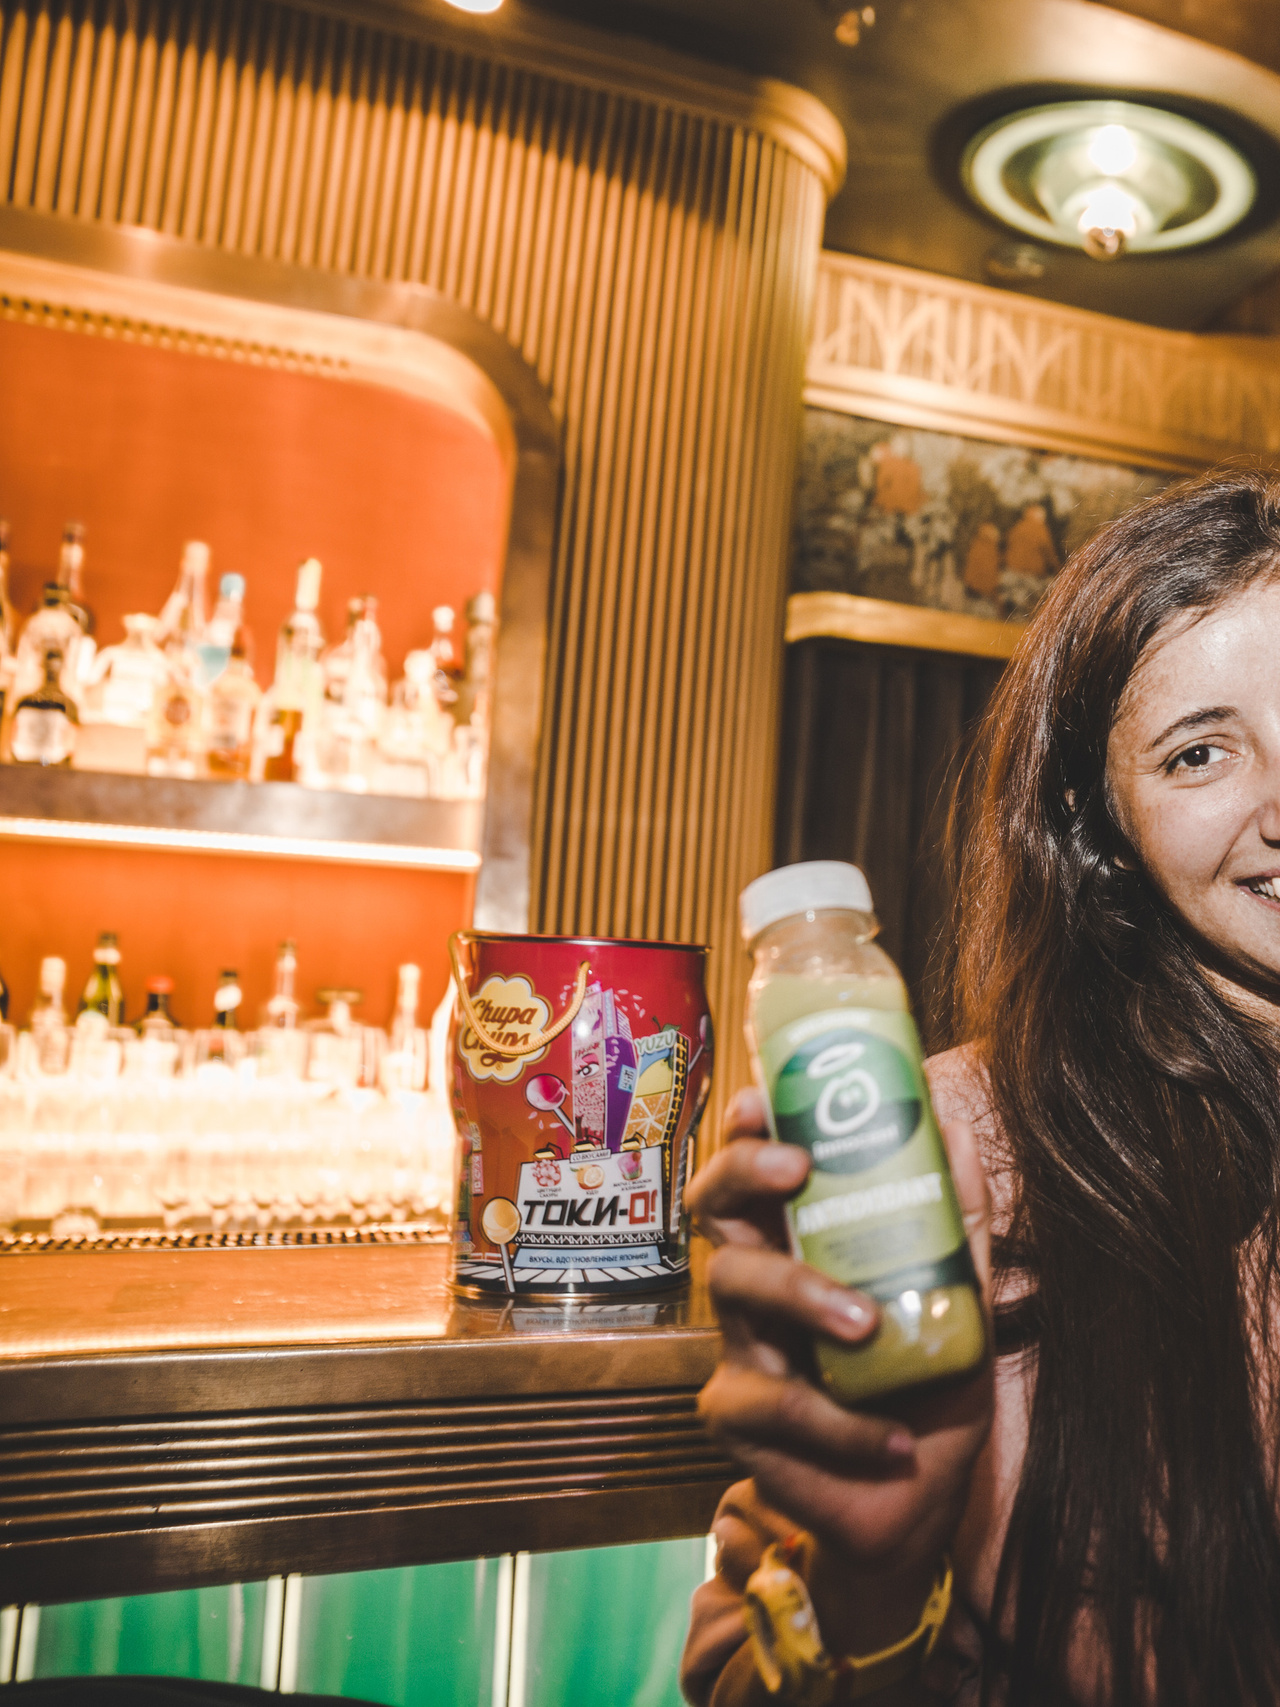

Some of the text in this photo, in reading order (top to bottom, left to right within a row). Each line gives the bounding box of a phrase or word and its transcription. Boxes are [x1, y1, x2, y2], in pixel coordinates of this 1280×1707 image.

[473, 999, 538, 1030] Chupa
[635, 1032, 675, 1053] YUZU
[523, 1188, 658, 1227] ТОКИ-О!
